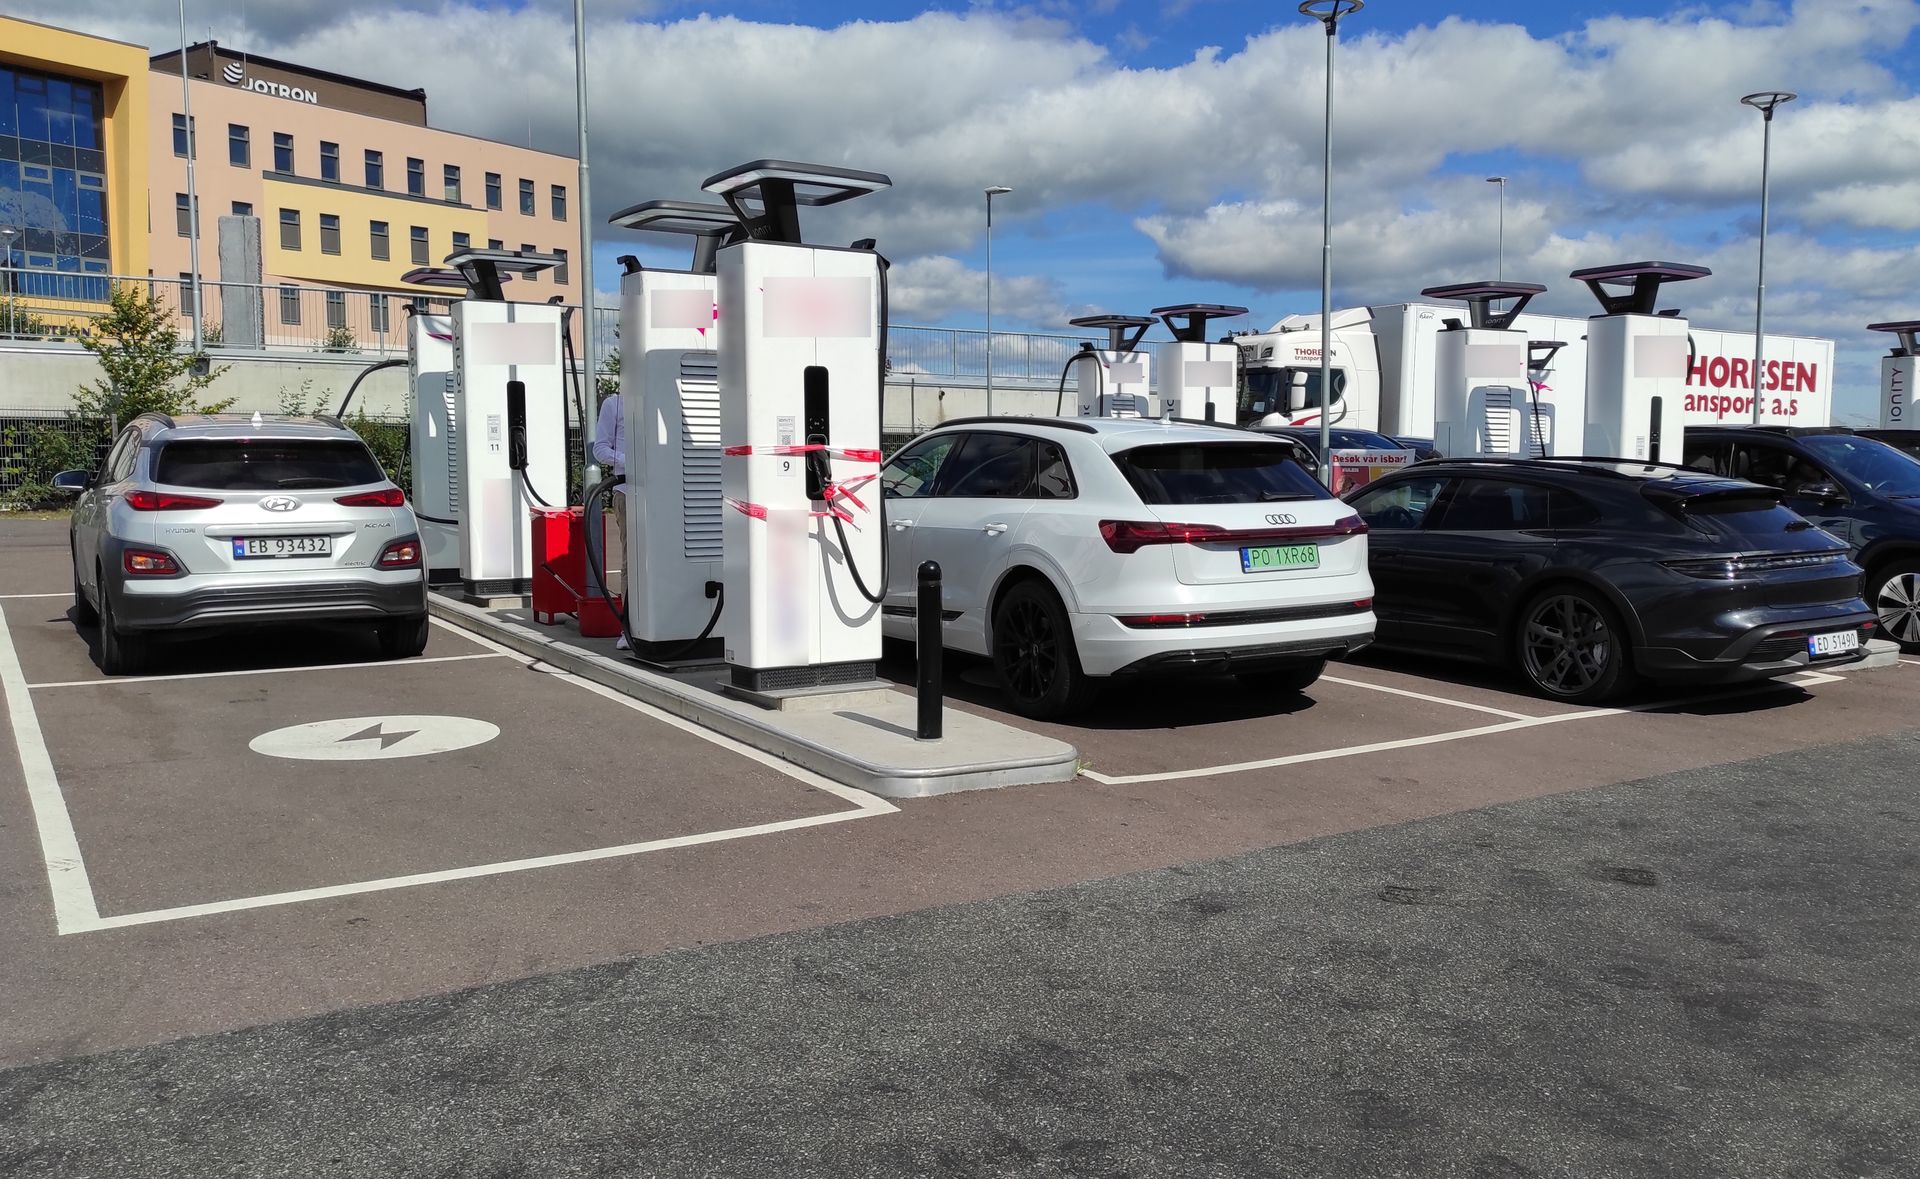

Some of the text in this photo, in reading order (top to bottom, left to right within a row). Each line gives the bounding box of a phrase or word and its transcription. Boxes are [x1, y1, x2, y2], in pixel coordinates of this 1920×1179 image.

[241, 78, 317, 103] JOTRON
[1294, 348, 1336, 356] THOREN
[1686, 355, 1817, 392] HORESEN
[1891, 368, 1903, 421] IONITY
[1684, 394, 1798, 419] ansport a.s
[783, 461, 790, 472] 9
[1332, 455, 1407, 463] Besøk vår isbar!
[249, 540, 268, 553] EB
[276, 538, 326, 552] 93432
[1252, 549, 1270, 566] PO
[1276, 547, 1315, 564] 1XR68
[1818, 633, 1856, 651] ED 51490
